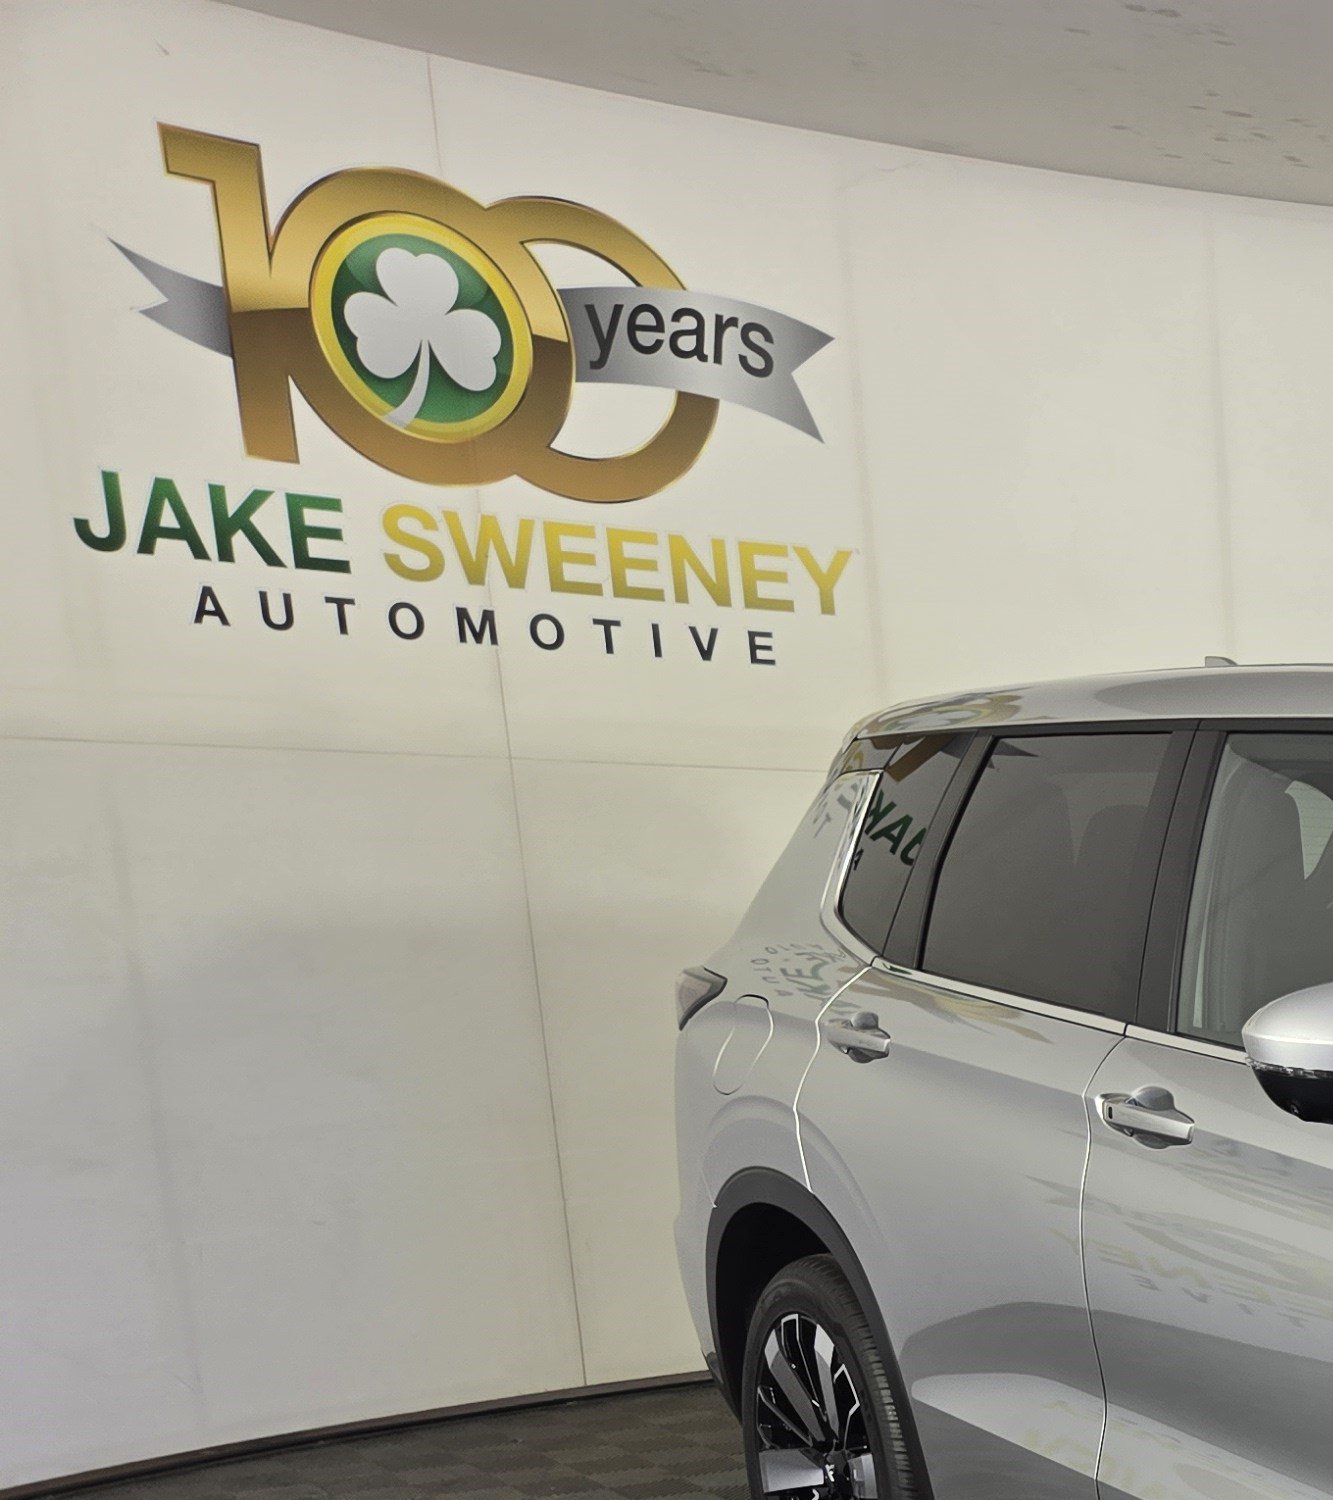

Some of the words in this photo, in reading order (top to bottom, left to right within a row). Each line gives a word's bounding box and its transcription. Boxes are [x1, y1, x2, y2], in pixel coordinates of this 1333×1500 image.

[584, 299, 776, 379] years
[73, 469, 353, 575] JAKE
[381, 504, 854, 617] SWEENEY
[193, 585, 777, 667] AUTOMOTIVE
